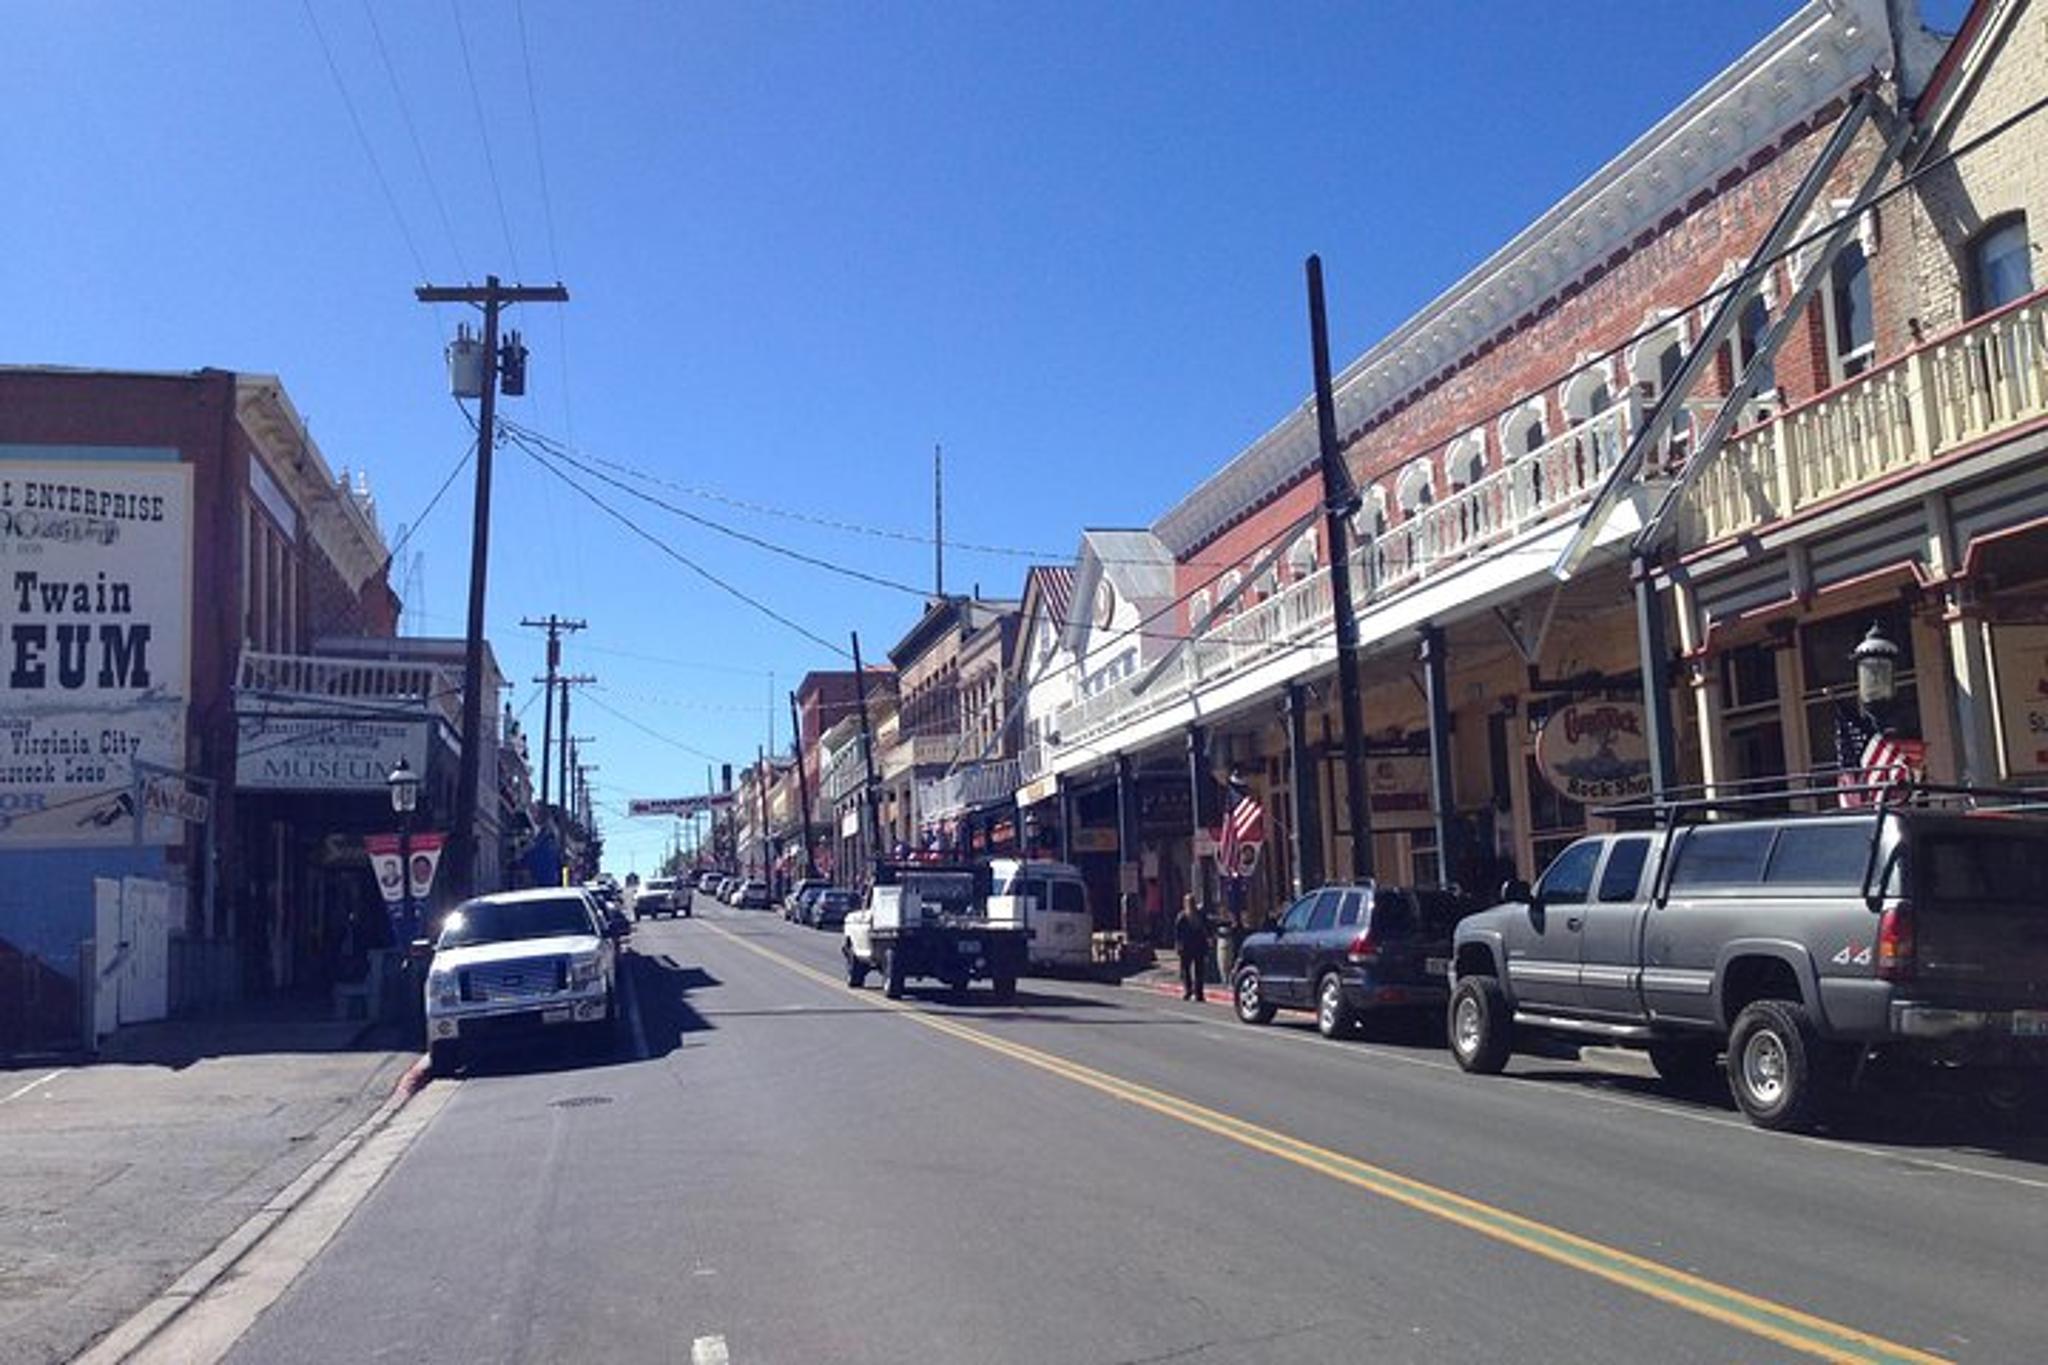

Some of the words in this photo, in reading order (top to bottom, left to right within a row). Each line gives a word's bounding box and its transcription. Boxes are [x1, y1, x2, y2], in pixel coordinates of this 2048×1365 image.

[25, 482, 164, 522] ENTERPRISE
[14, 571, 132, 614] Twain
[10, 624, 152, 690] EUM
[11, 730, 90, 755] Virginia
[100, 730, 141, 760] City
[1567, 778, 1613, 798] Rock
